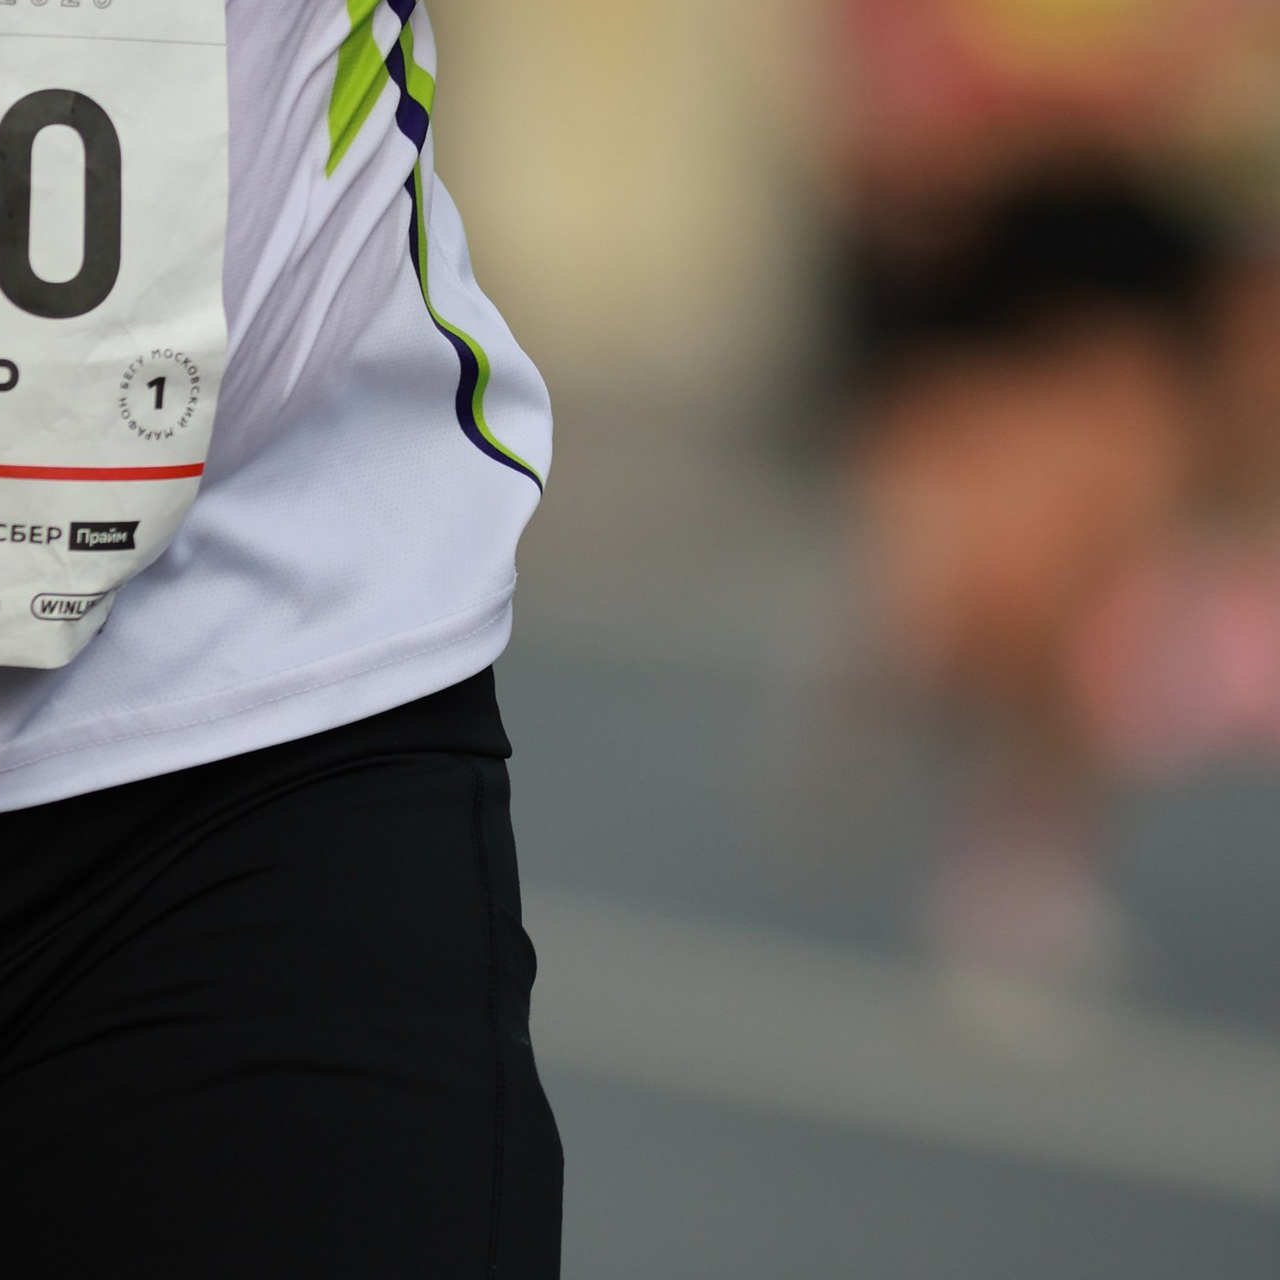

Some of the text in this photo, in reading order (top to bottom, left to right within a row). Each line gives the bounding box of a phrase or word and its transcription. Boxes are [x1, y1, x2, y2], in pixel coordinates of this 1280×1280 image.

[147, 376, 167, 410] 1
[151, 348, 201, 428] МОСКОВСКИЙ
[118, 396, 174, 441] МАРАФОН
[76, 528, 129, 547] Прайм
